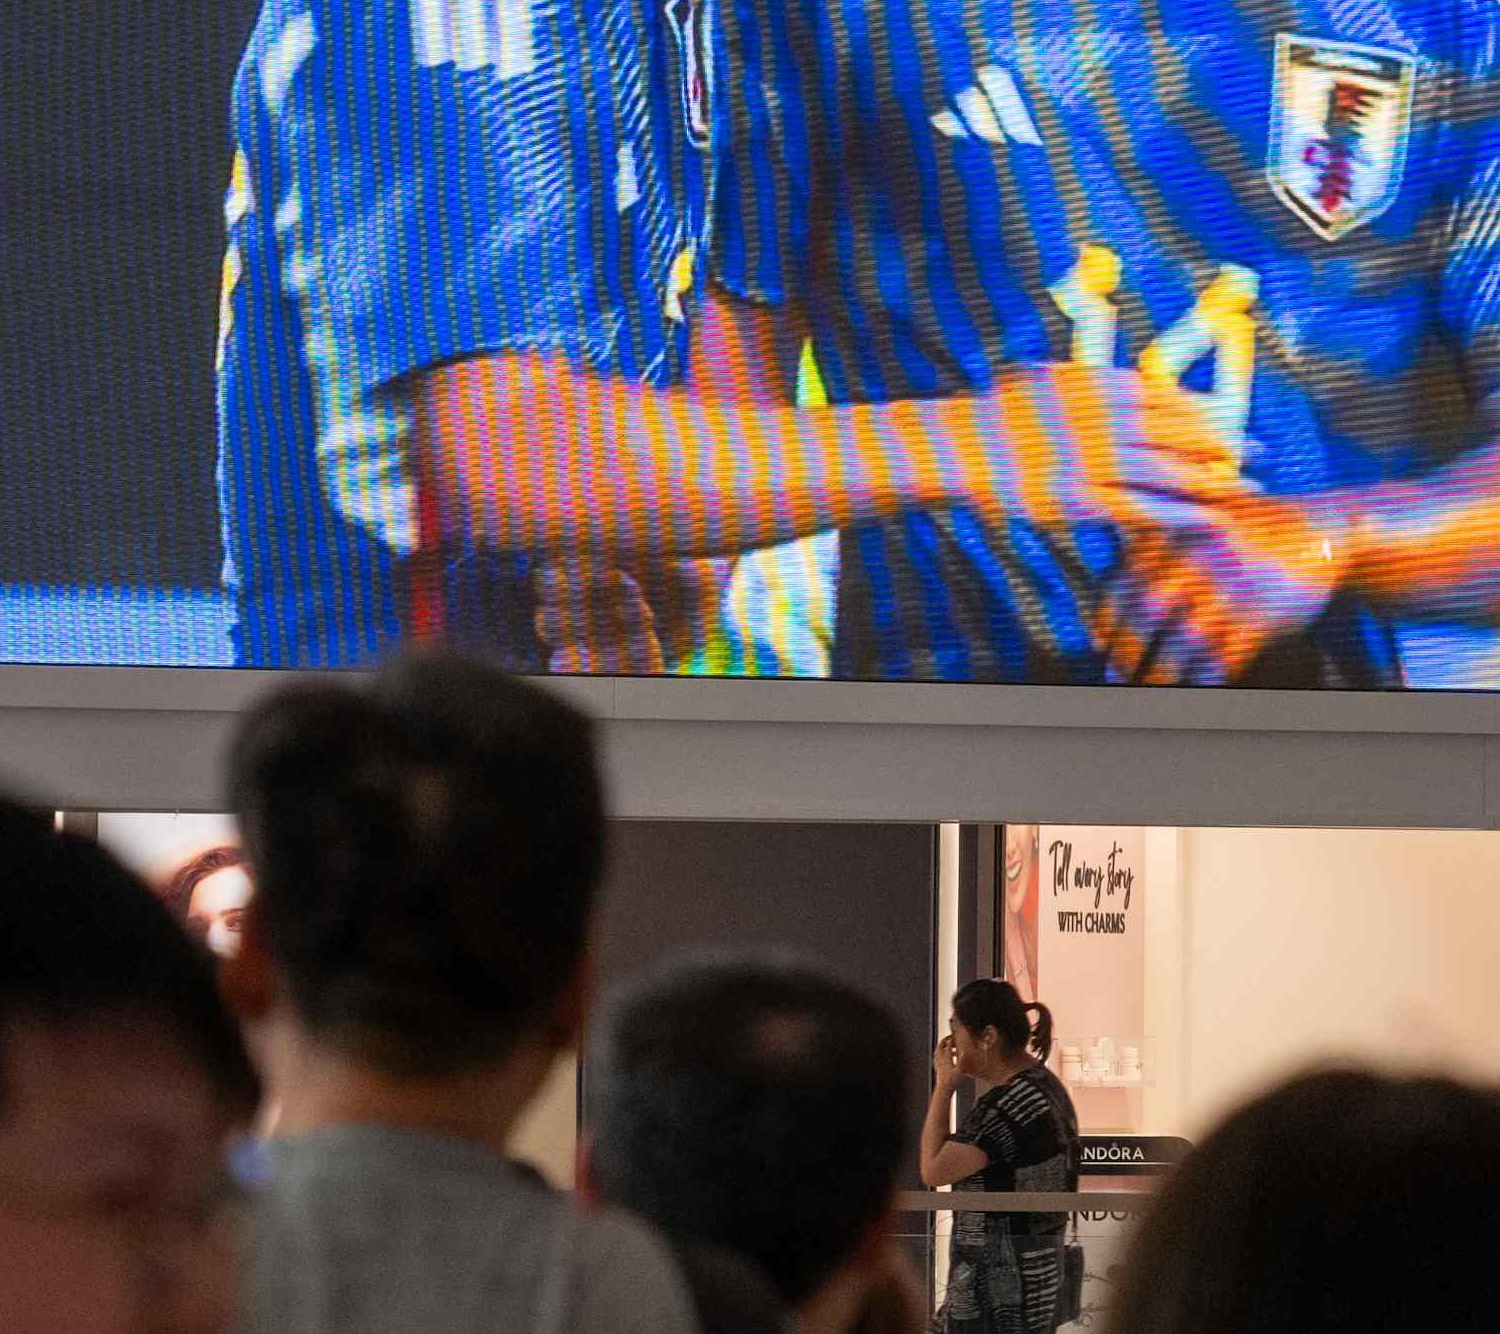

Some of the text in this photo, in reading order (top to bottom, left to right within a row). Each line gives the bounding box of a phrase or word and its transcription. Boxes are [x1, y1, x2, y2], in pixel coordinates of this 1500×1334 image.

[1048, 840, 1134, 910] Tell every story
[1057, 911, 1126, 934] WITH CHARMS
[1081, 1144, 1145, 1161] NDORA
